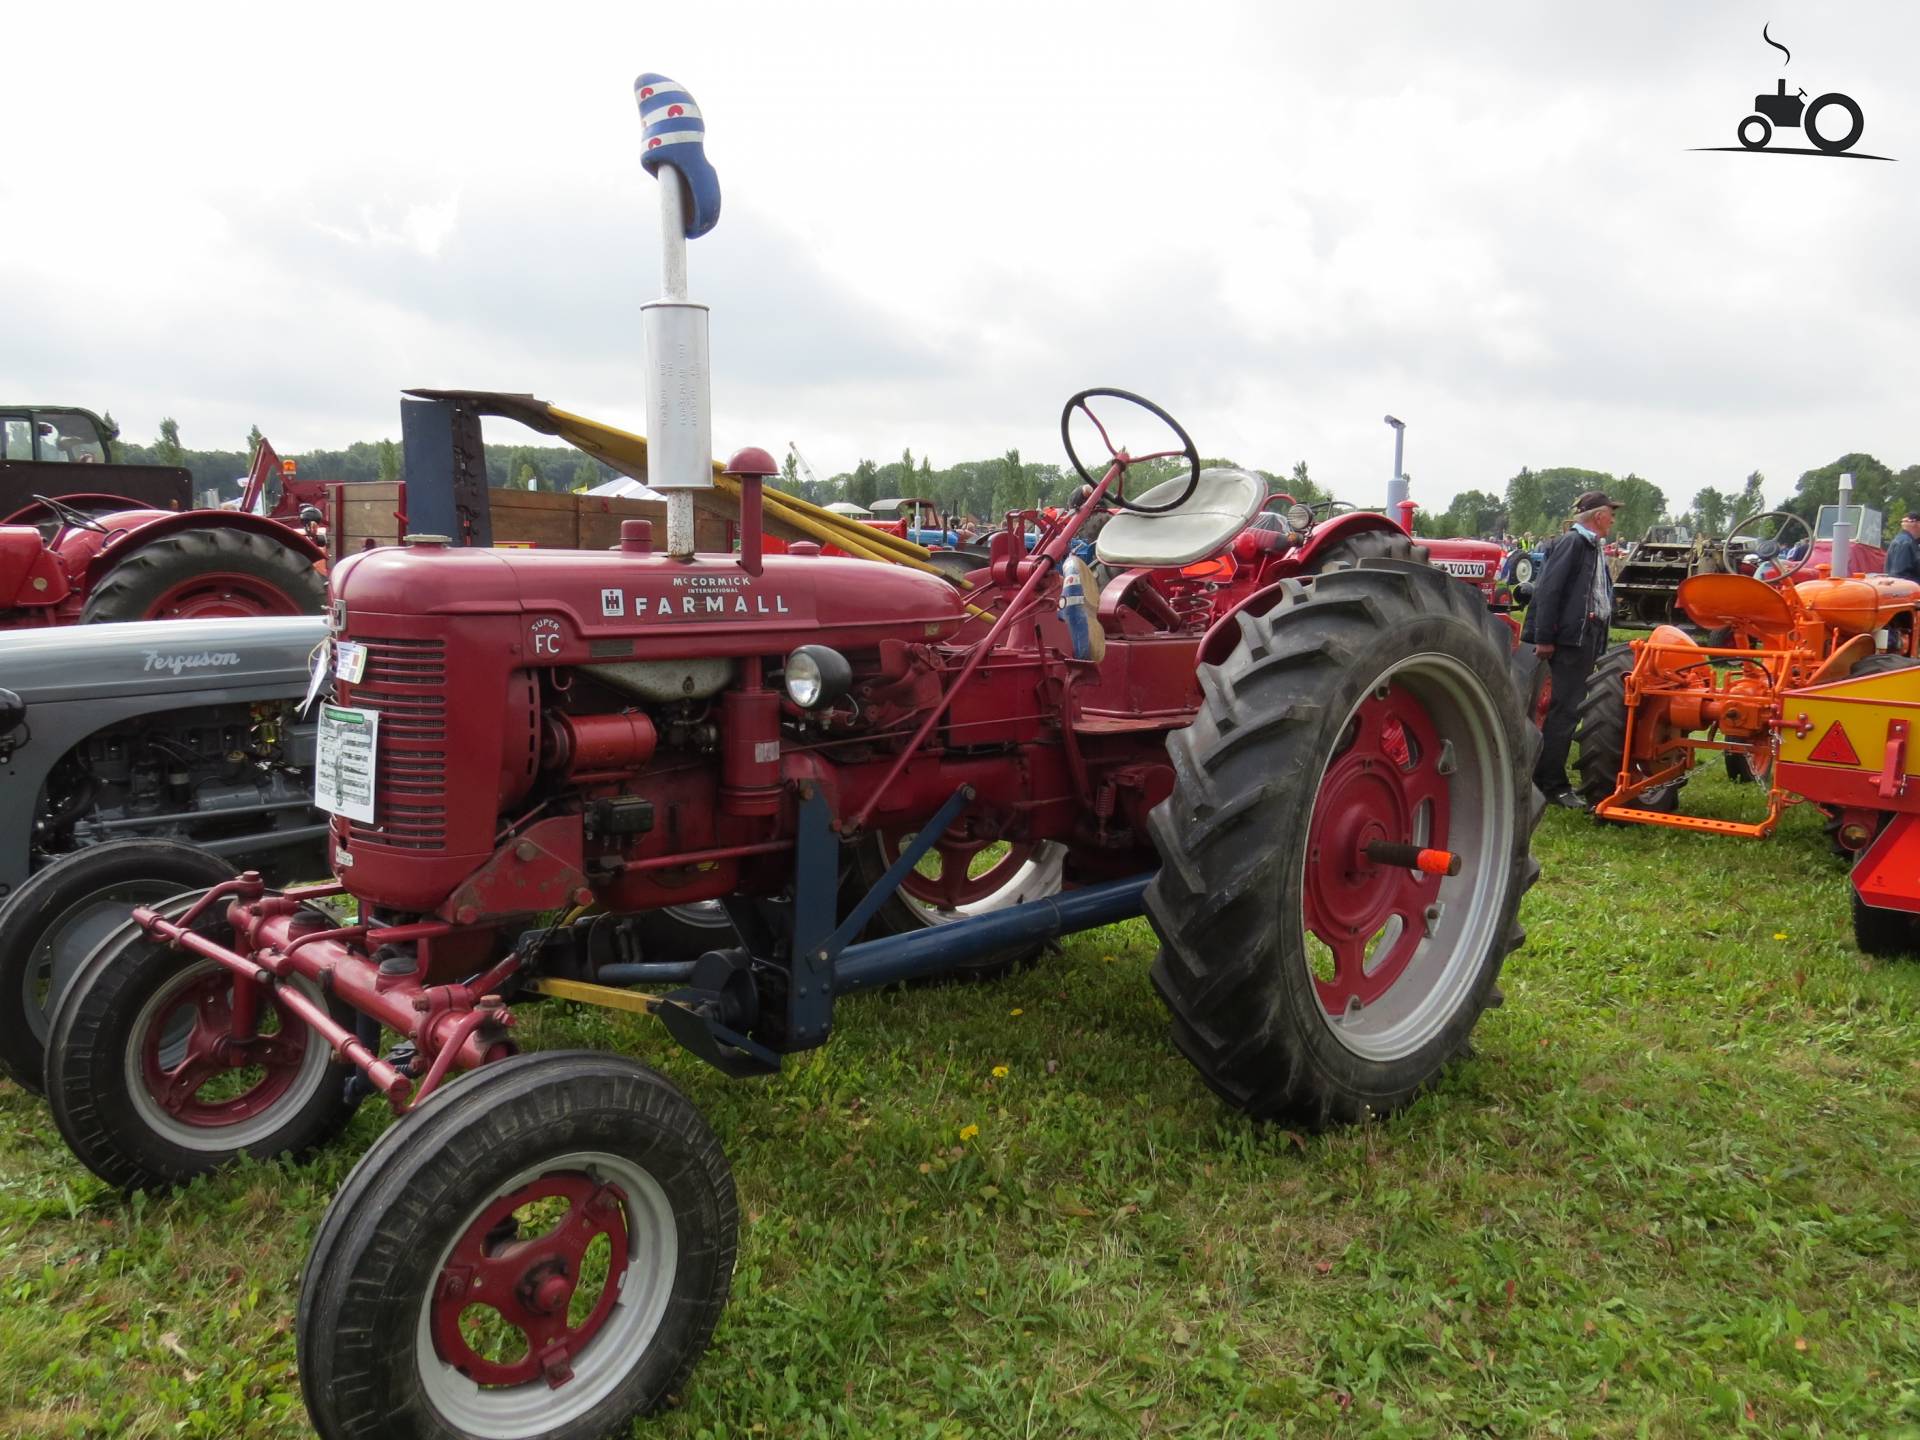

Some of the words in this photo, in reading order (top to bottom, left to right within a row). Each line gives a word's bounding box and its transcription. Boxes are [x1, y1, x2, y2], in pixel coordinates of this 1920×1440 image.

[1448, 563, 1484, 576] VOLVO
[634, 594, 789, 616] FARMALL
[531, 618, 560, 632] SUPER
[535, 633, 560, 654] FC
[141, 649, 241, 676] Ferguson
